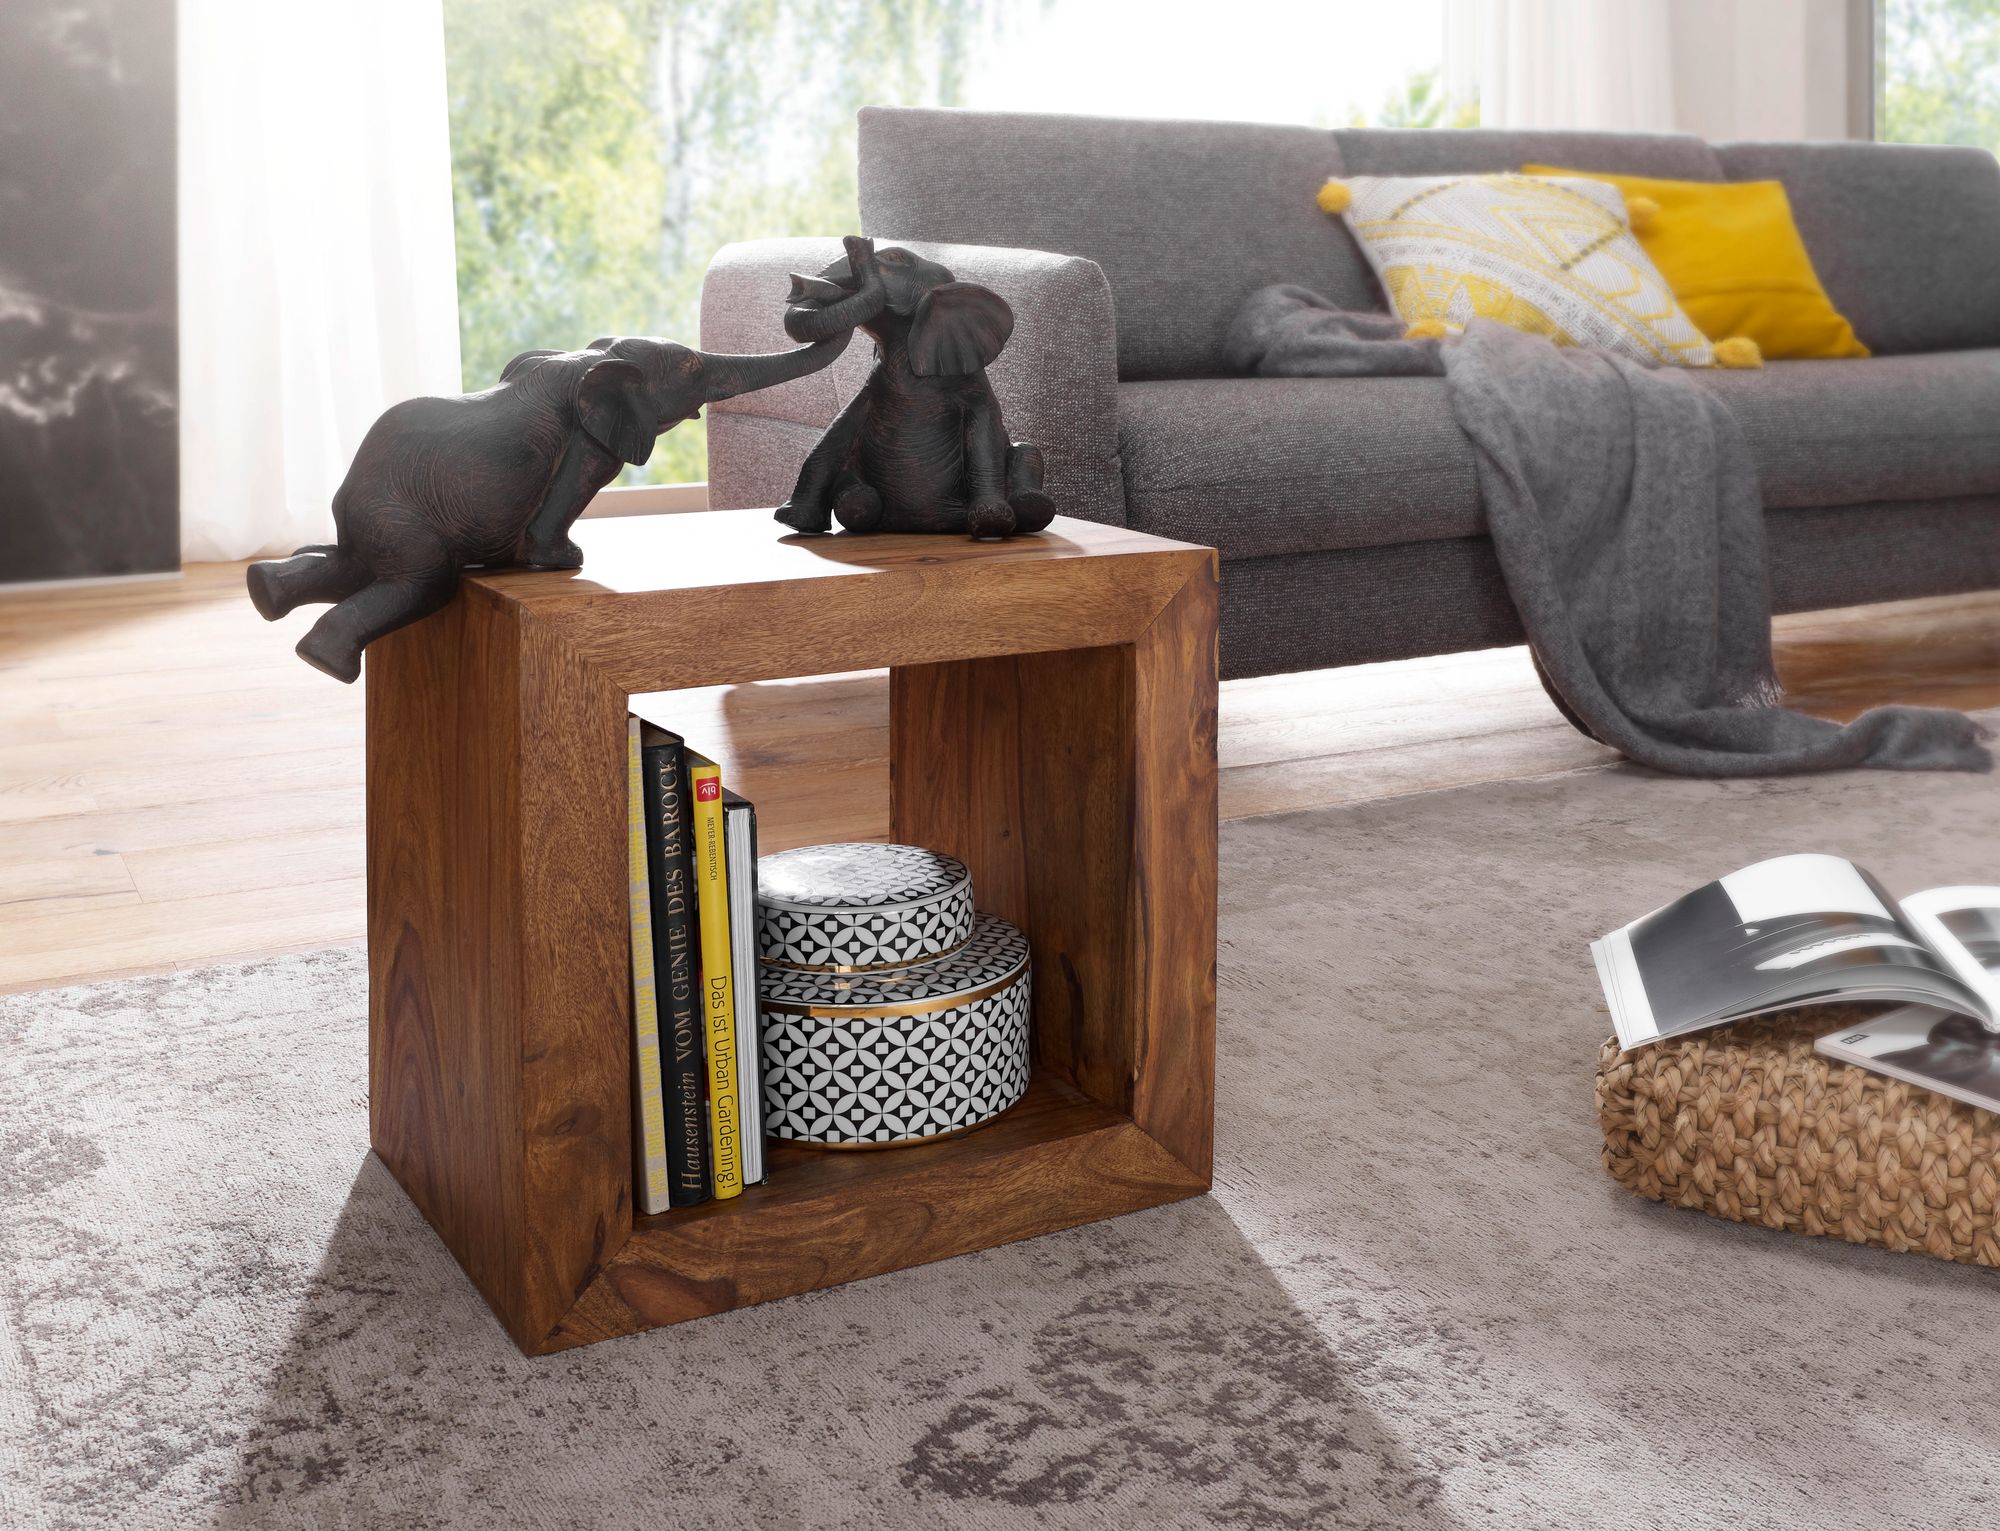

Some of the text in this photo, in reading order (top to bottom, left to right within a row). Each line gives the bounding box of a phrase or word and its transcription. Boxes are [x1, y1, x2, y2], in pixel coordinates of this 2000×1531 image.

[701, 786, 717, 795] blv
[706, 817, 718, 881] MEYER-REBENTISCH
[632, 928, 653, 979] DESIGN
[659, 754, 702, 1190] Hausenstein VOM GENIE DES BAROCK
[638, 985, 657, 1036] MATRIX
[640, 1045, 659, 1092] MARTA
[710, 976, 738, 1189] Das ist Urban Gardening!
[643, 1095, 664, 1158] HERFORD
